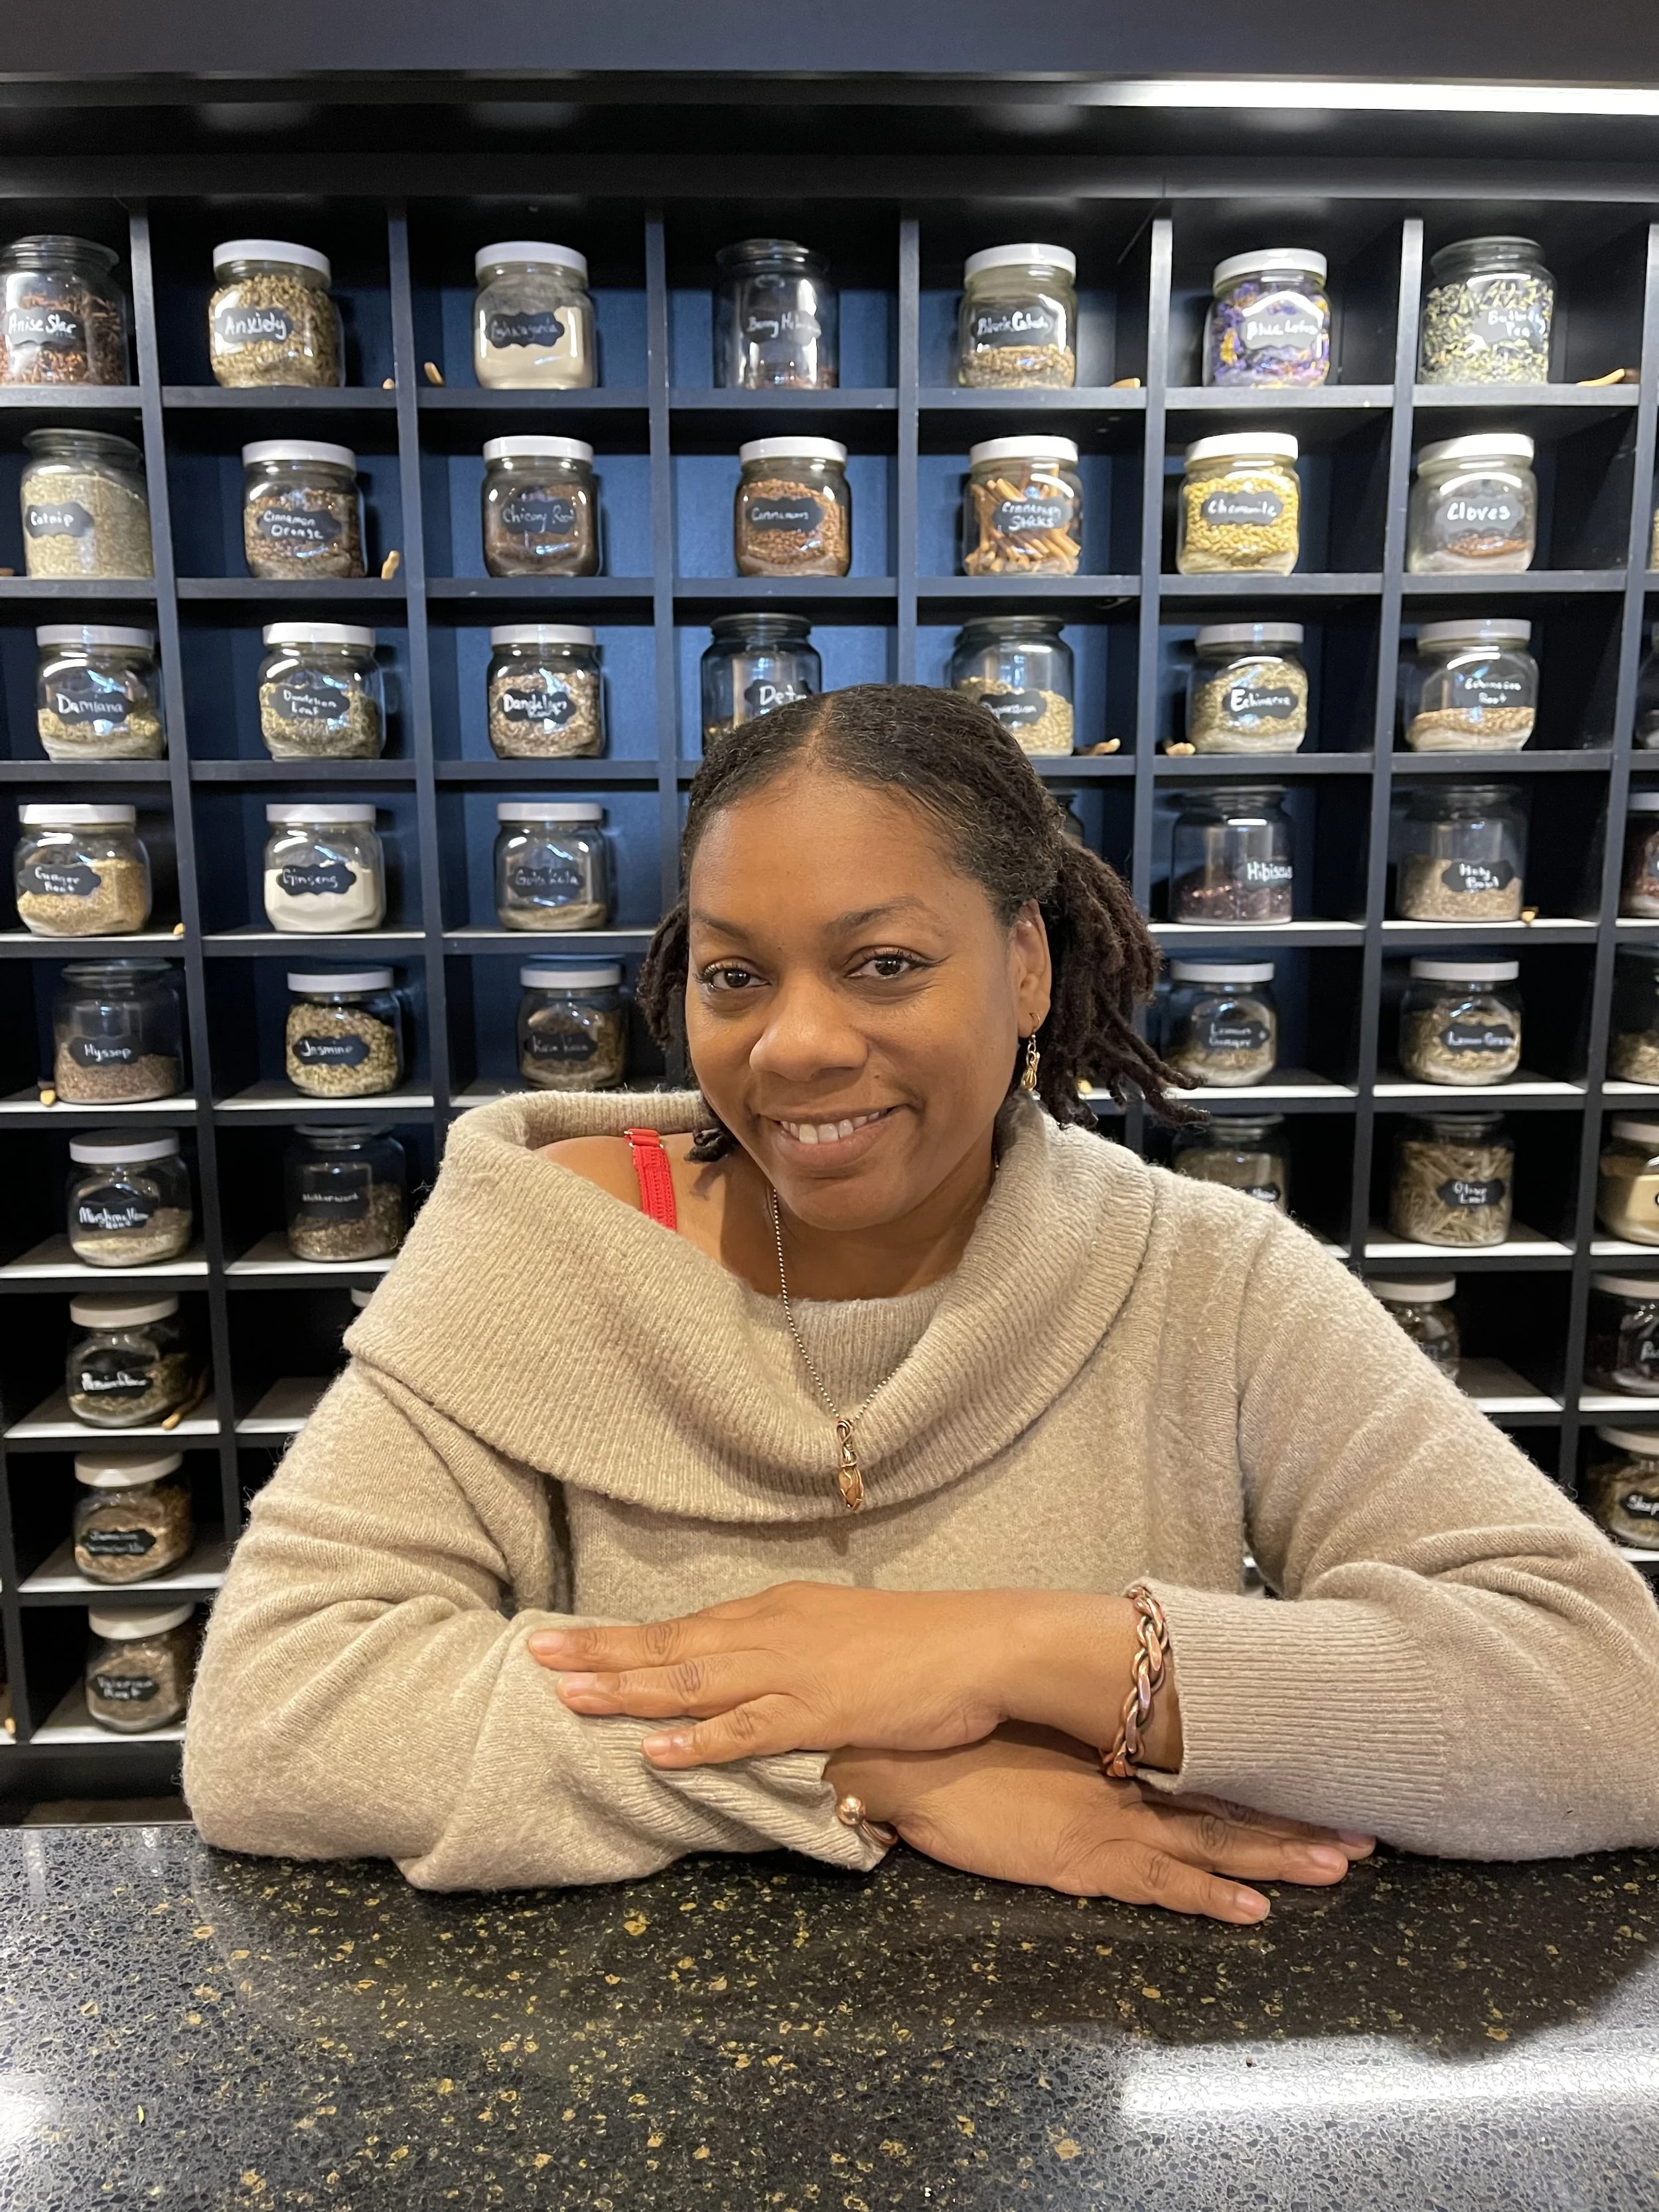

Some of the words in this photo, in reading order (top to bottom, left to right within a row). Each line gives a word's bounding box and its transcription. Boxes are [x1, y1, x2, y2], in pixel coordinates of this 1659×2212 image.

[9, 312, 44, 334] Anise
[45, 314, 77, 336] Star
[225, 312, 287, 340] Anxiety
[1506, 321, 1531, 337] Pea
[1447, 498, 1511, 518] Cloves
[31, 510, 74, 528] Catnip
[271, 524, 325, 540] Orange
[56, 693, 125, 715] Damiana
[282, 868, 338, 887] Ginseng
[1247, 861, 1293, 882] Hibiscus
[84, 1043, 132, 1062] Hyssop
[299, 1040, 354, 1057] Jasmine
